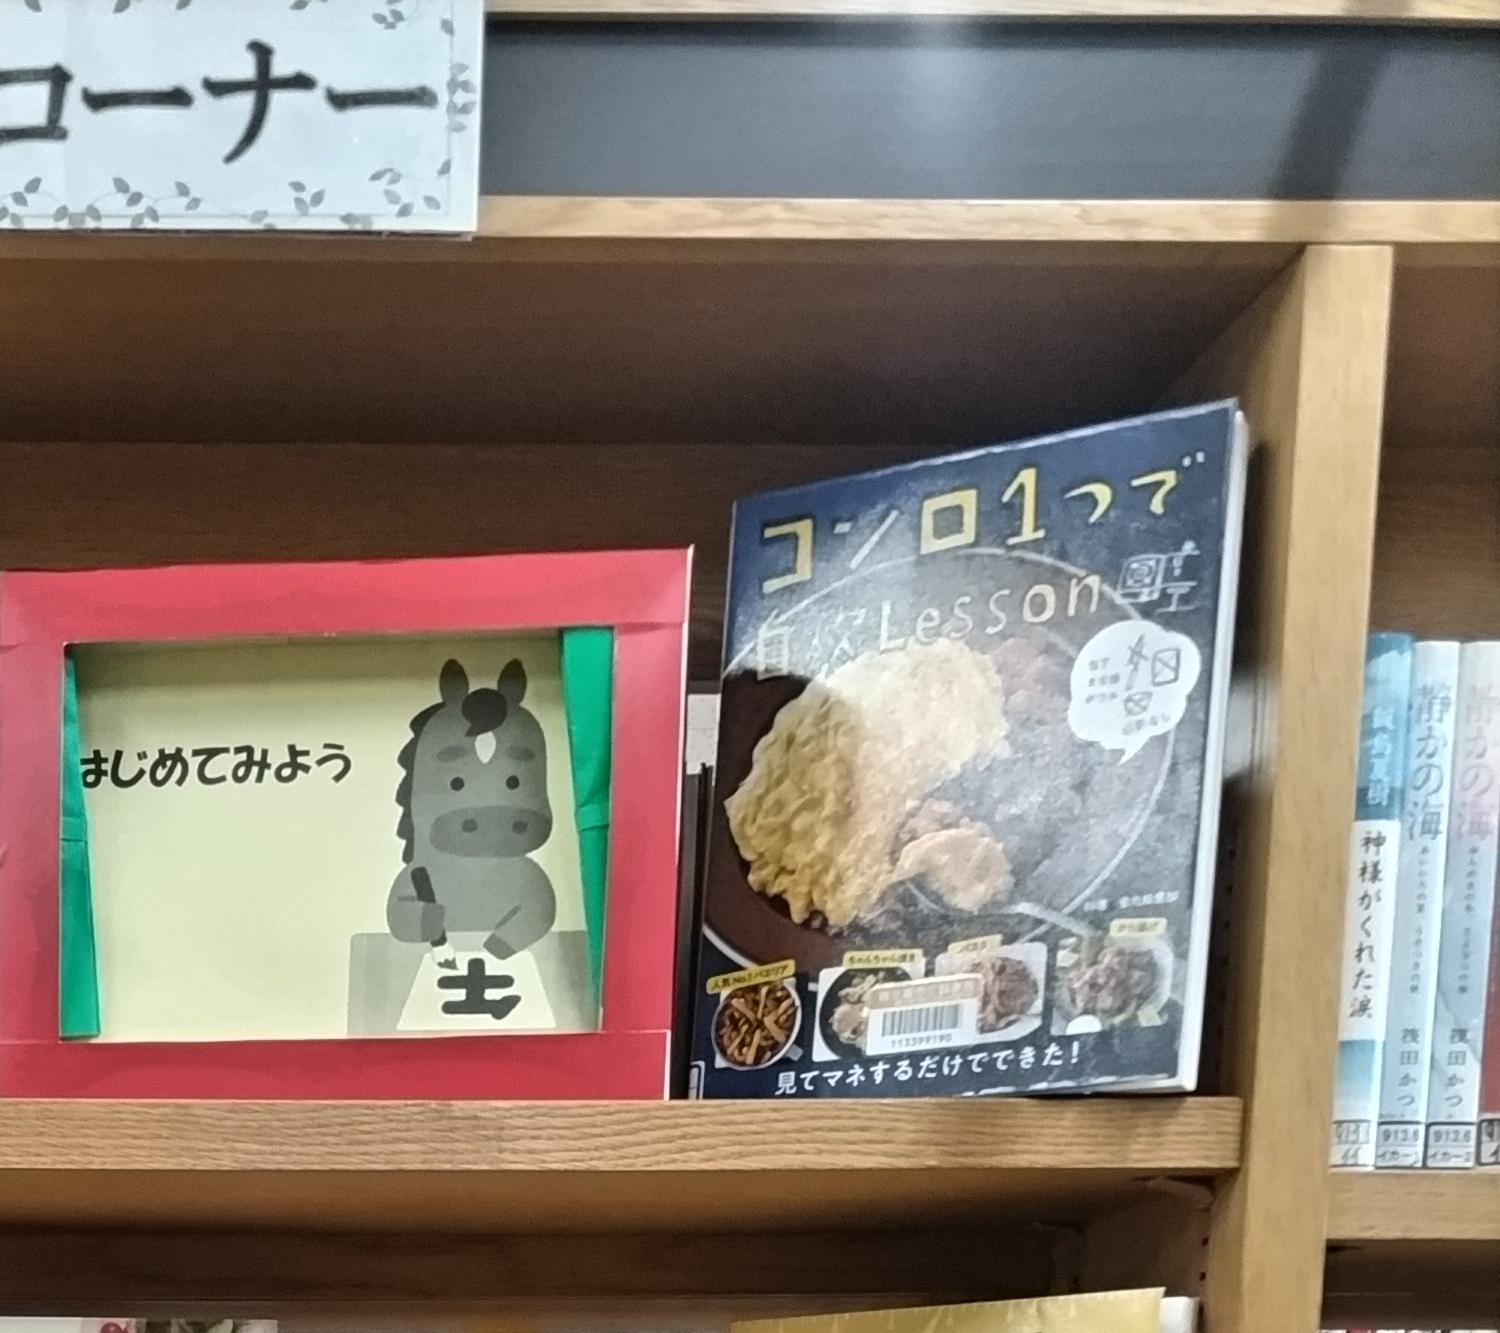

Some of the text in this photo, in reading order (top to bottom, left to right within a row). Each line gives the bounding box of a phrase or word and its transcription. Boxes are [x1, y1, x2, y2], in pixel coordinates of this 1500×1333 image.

[762, 440, 1207, 594] コンロ1つで
[1348, 830, 1388, 1021] 神様がくれた涙
[774, 1042, 1081, 1097] 見てマネするだけでできた!
